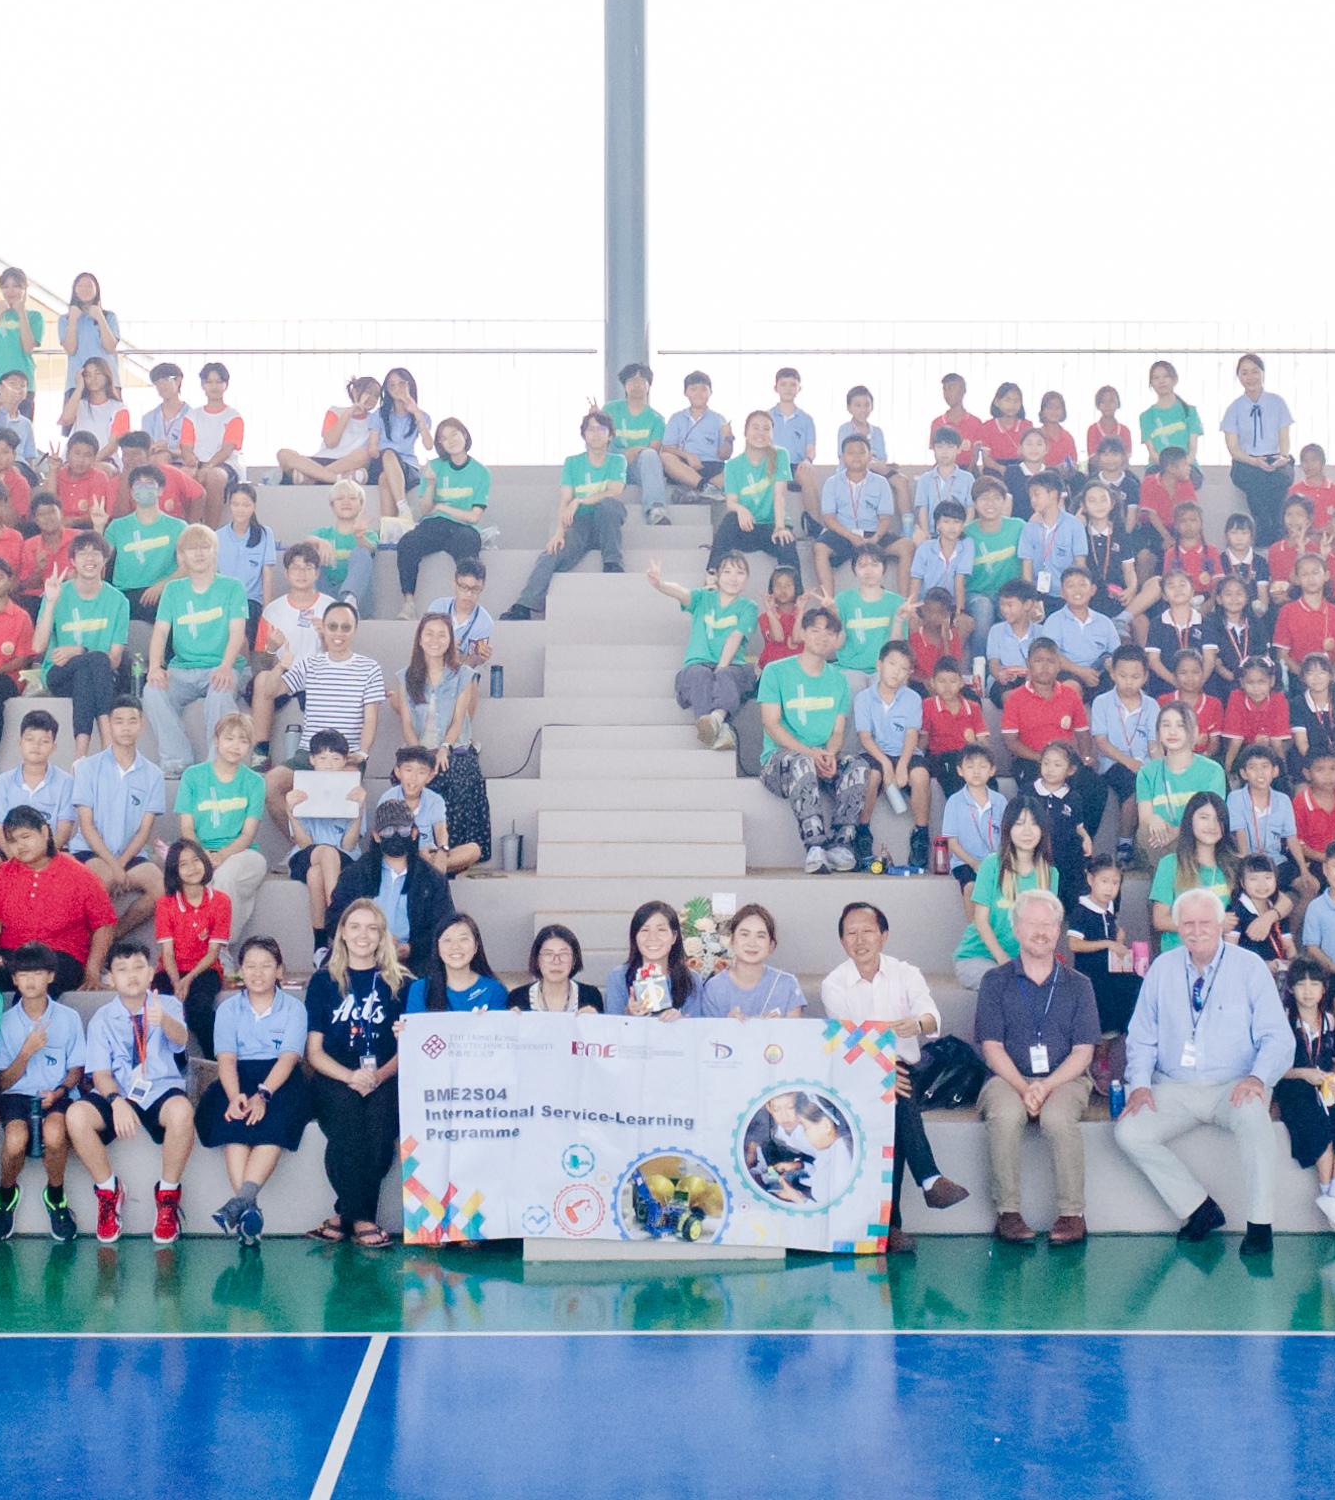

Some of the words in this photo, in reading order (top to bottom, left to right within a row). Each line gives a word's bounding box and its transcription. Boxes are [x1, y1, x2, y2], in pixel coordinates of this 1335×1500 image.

[331, 989, 385, 1025] Acts
[424, 1087, 508, 1102] BME2S04
[425, 1104, 534, 1121] International
[541, 1104, 695, 1130] Service-Learning
[426, 1127, 520, 1141] Programme
